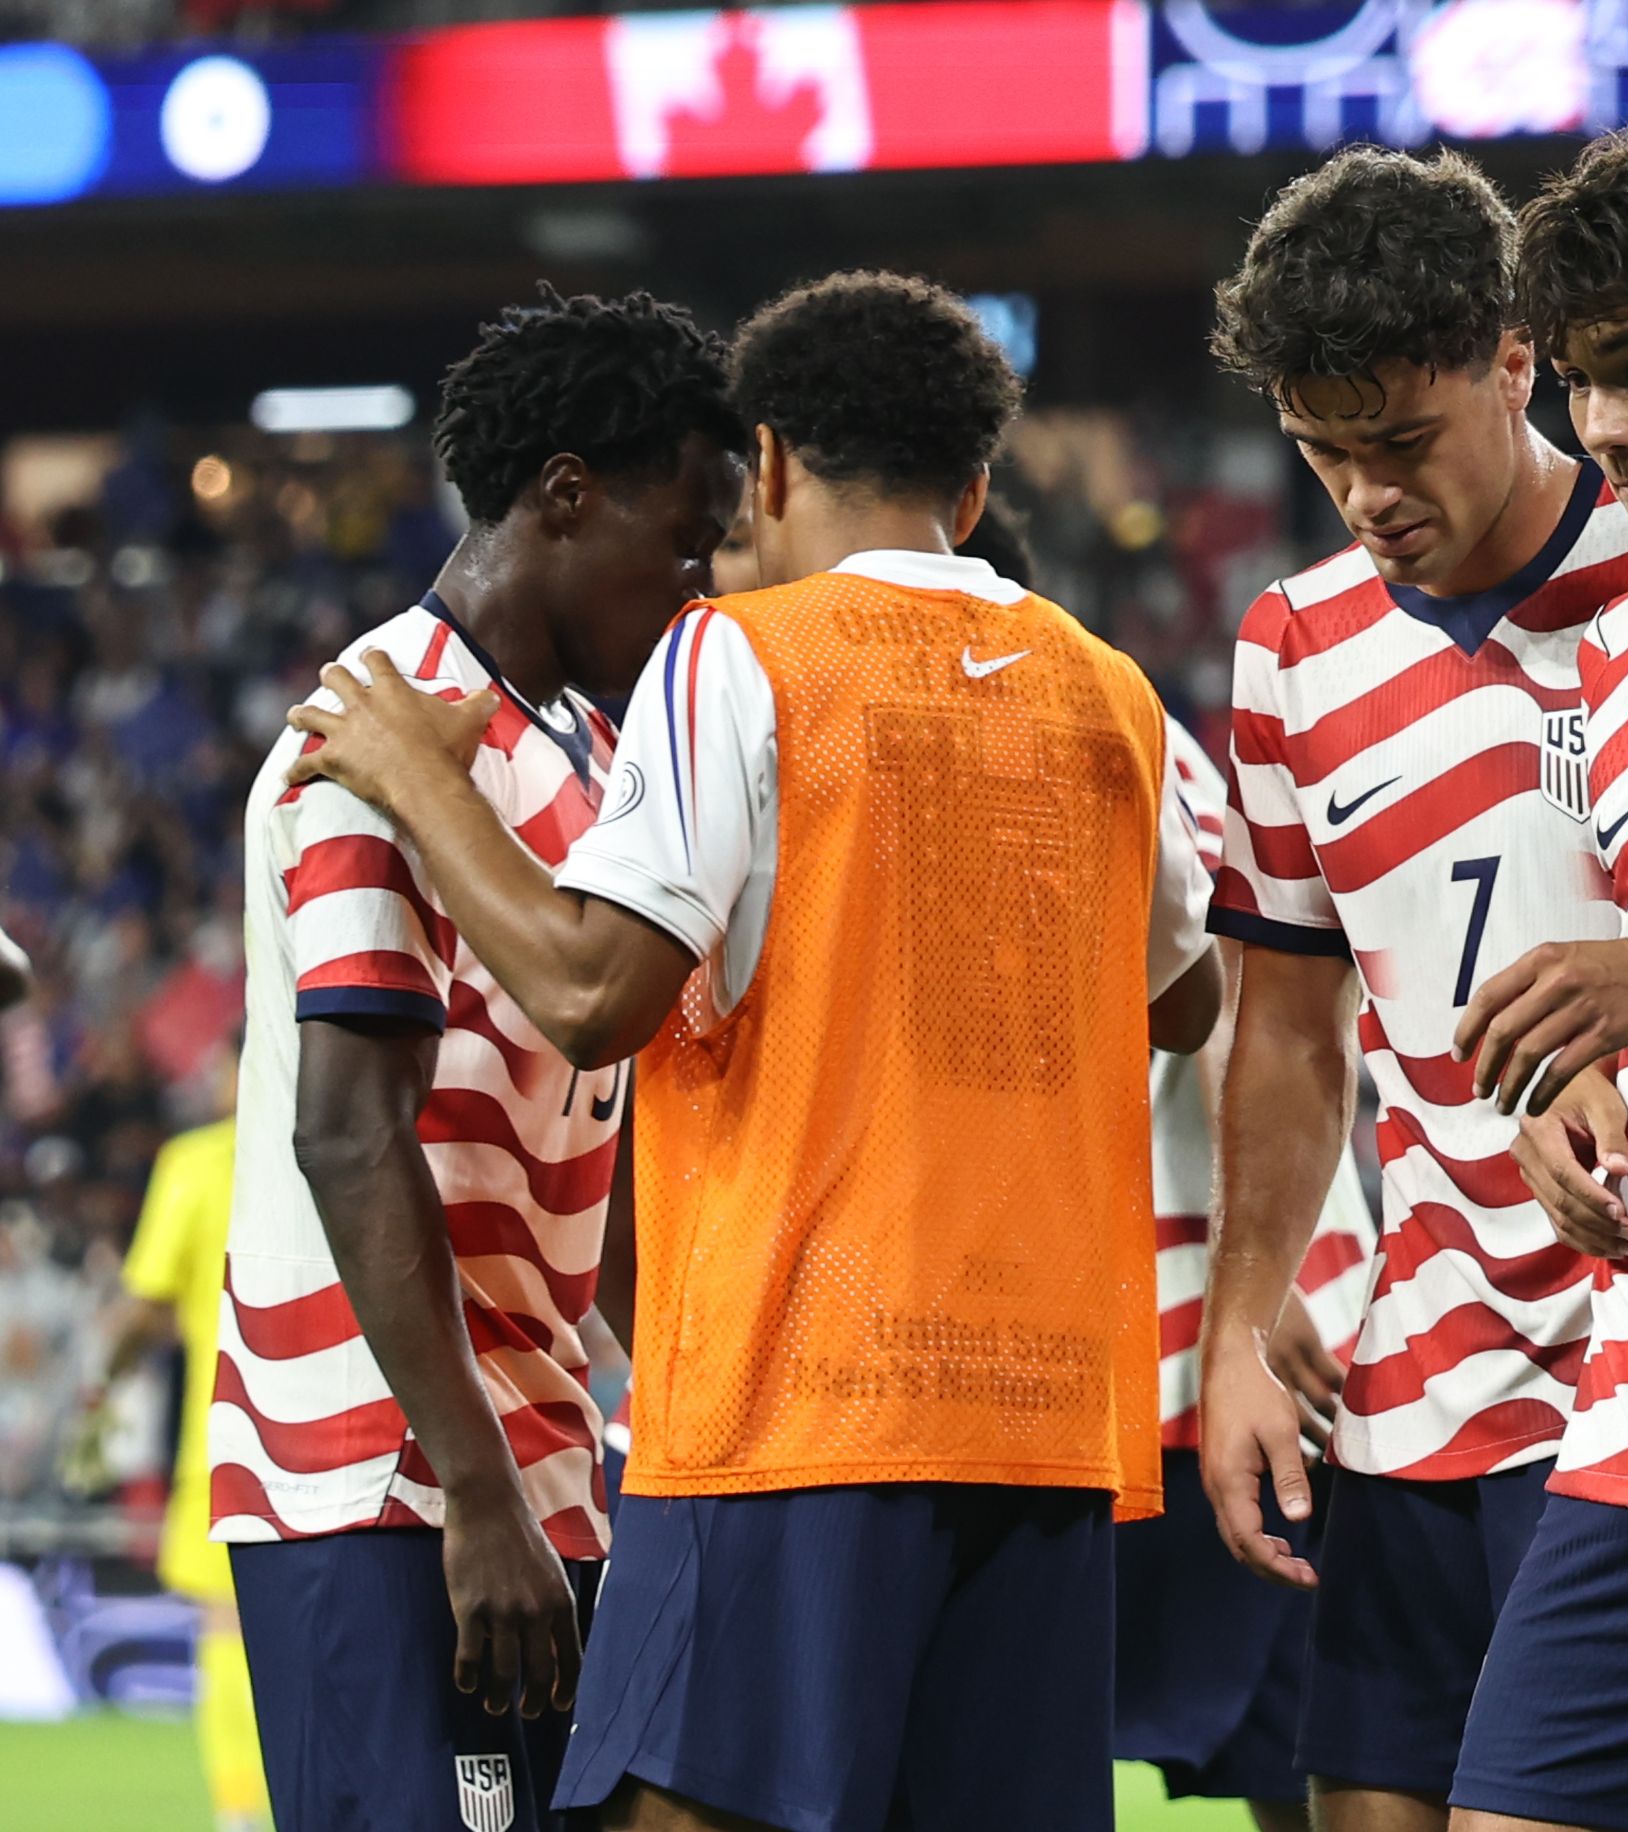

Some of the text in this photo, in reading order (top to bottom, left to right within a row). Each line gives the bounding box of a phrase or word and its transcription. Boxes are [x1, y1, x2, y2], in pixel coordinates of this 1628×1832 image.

[1546, 714, 1585, 756] US
[1451, 854, 1502, 1008] 7
[460, 1758, 508, 1792] USA
